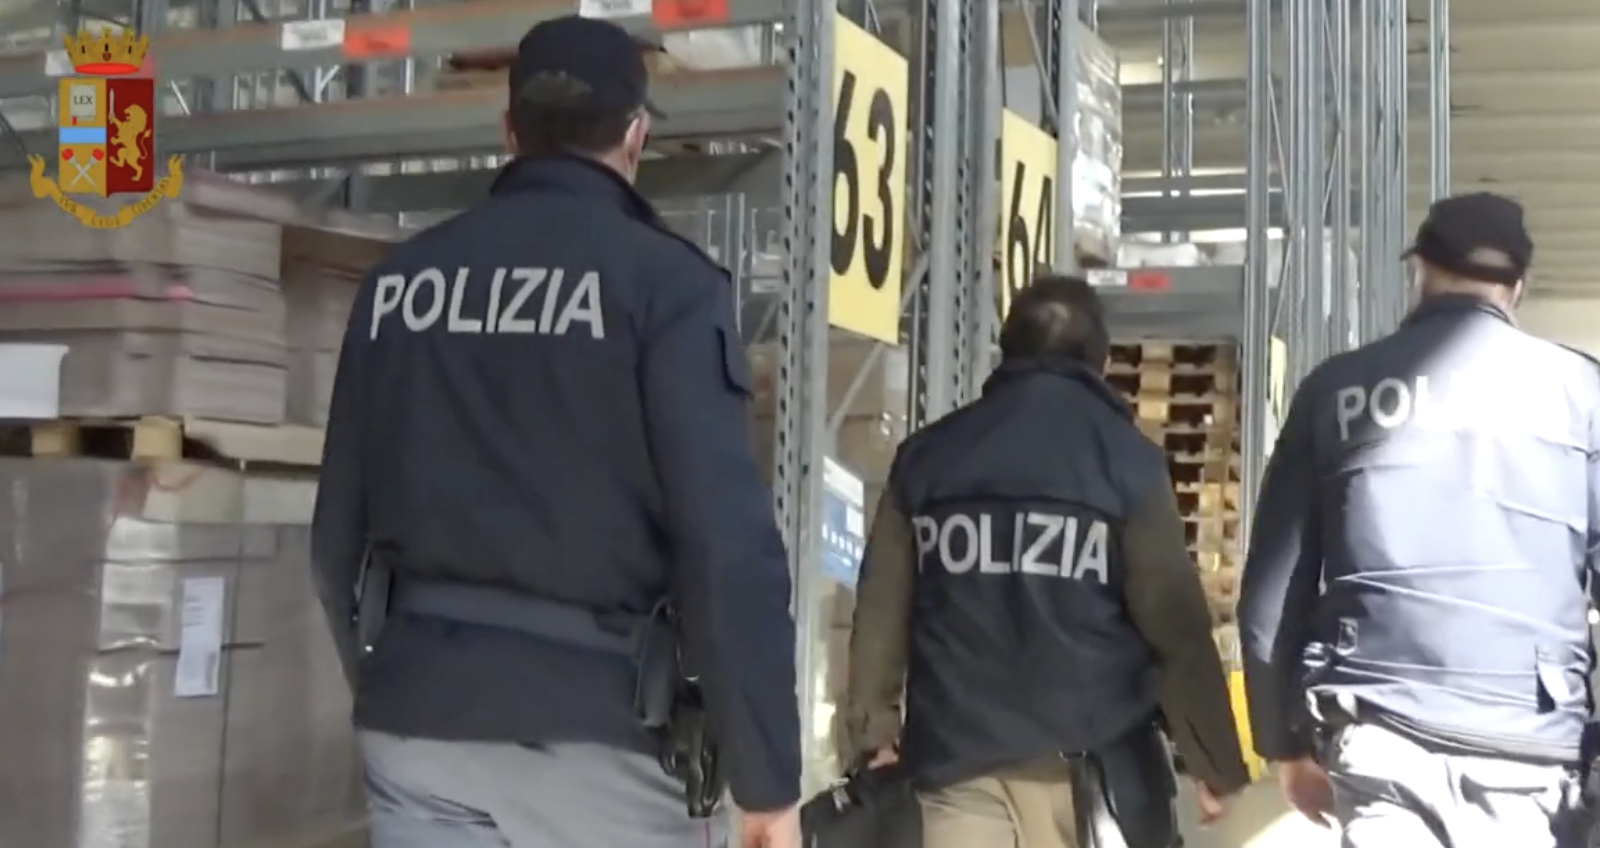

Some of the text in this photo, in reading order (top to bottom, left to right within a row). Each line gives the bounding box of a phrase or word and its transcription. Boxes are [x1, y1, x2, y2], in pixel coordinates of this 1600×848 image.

[829, 69, 895, 290] 63
[1007, 160, 1052, 291] 64
[370, 266, 605, 341] POLIZIA
[911, 511, 1108, 585] POLIZIA
